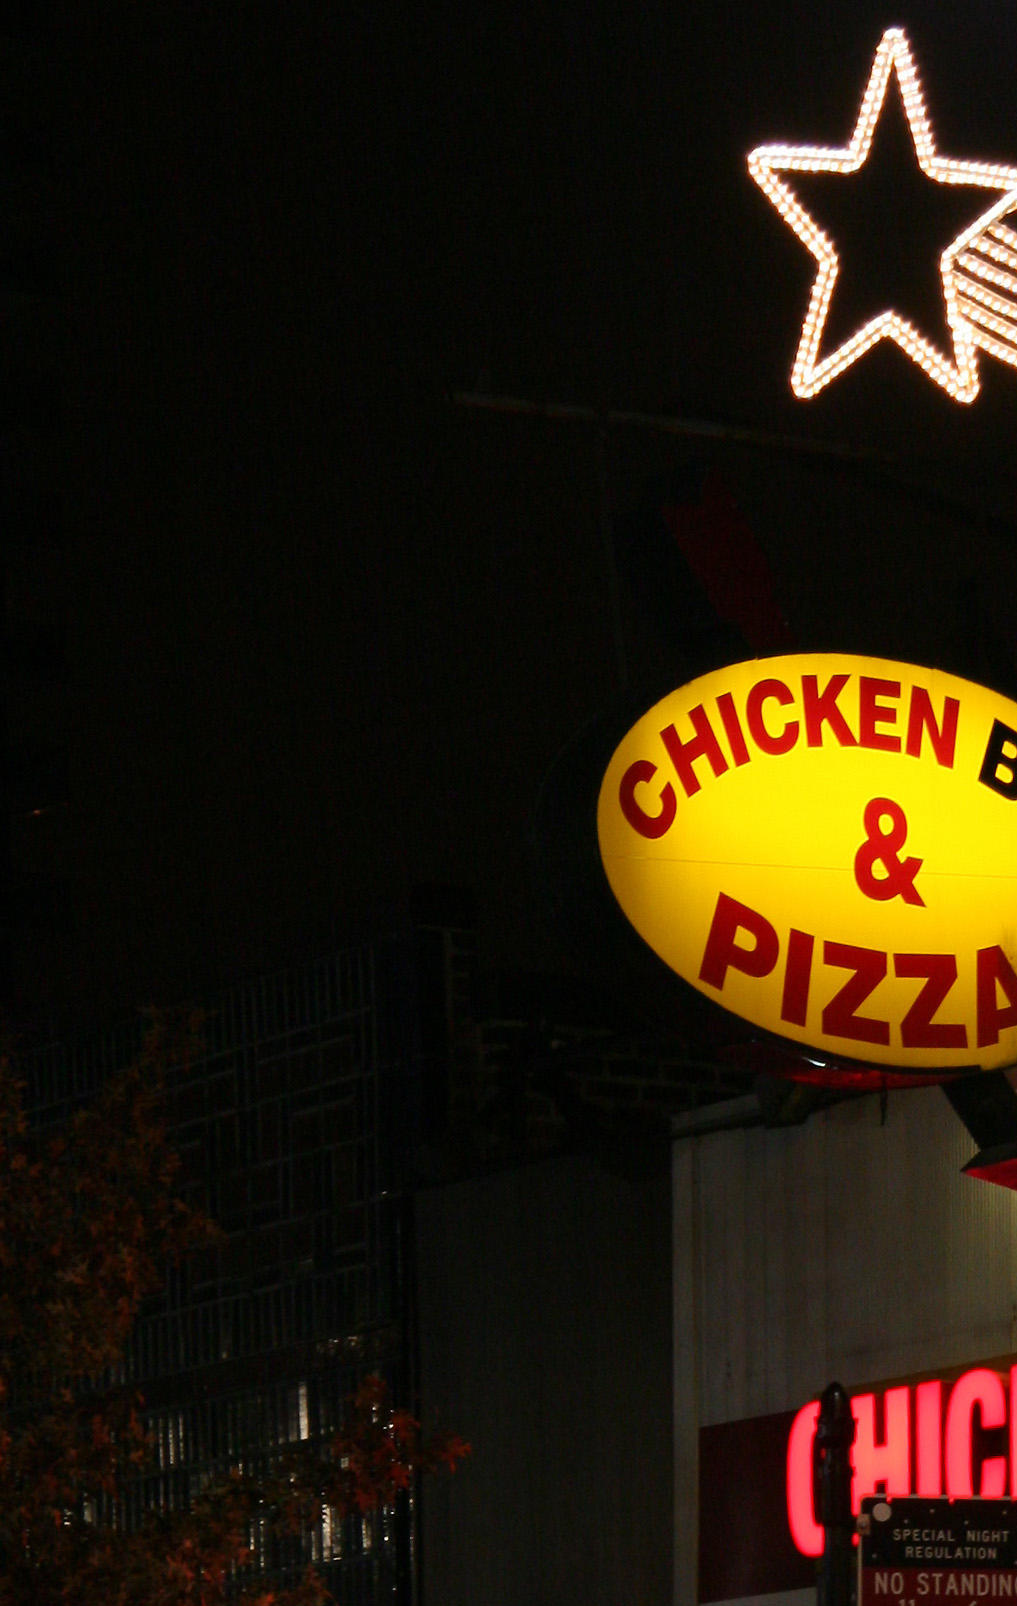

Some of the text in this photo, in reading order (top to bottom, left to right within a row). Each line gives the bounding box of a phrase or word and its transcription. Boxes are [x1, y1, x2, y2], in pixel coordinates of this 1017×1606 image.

[618, 674, 960, 840] CHICKEN
[853, 797, 926, 908] &
[893, 1529, 1010, 1543] SPECIAL NIGHT
[905, 1547, 997, 1560] REGULATION
[874, 1572, 904, 1596] NO
